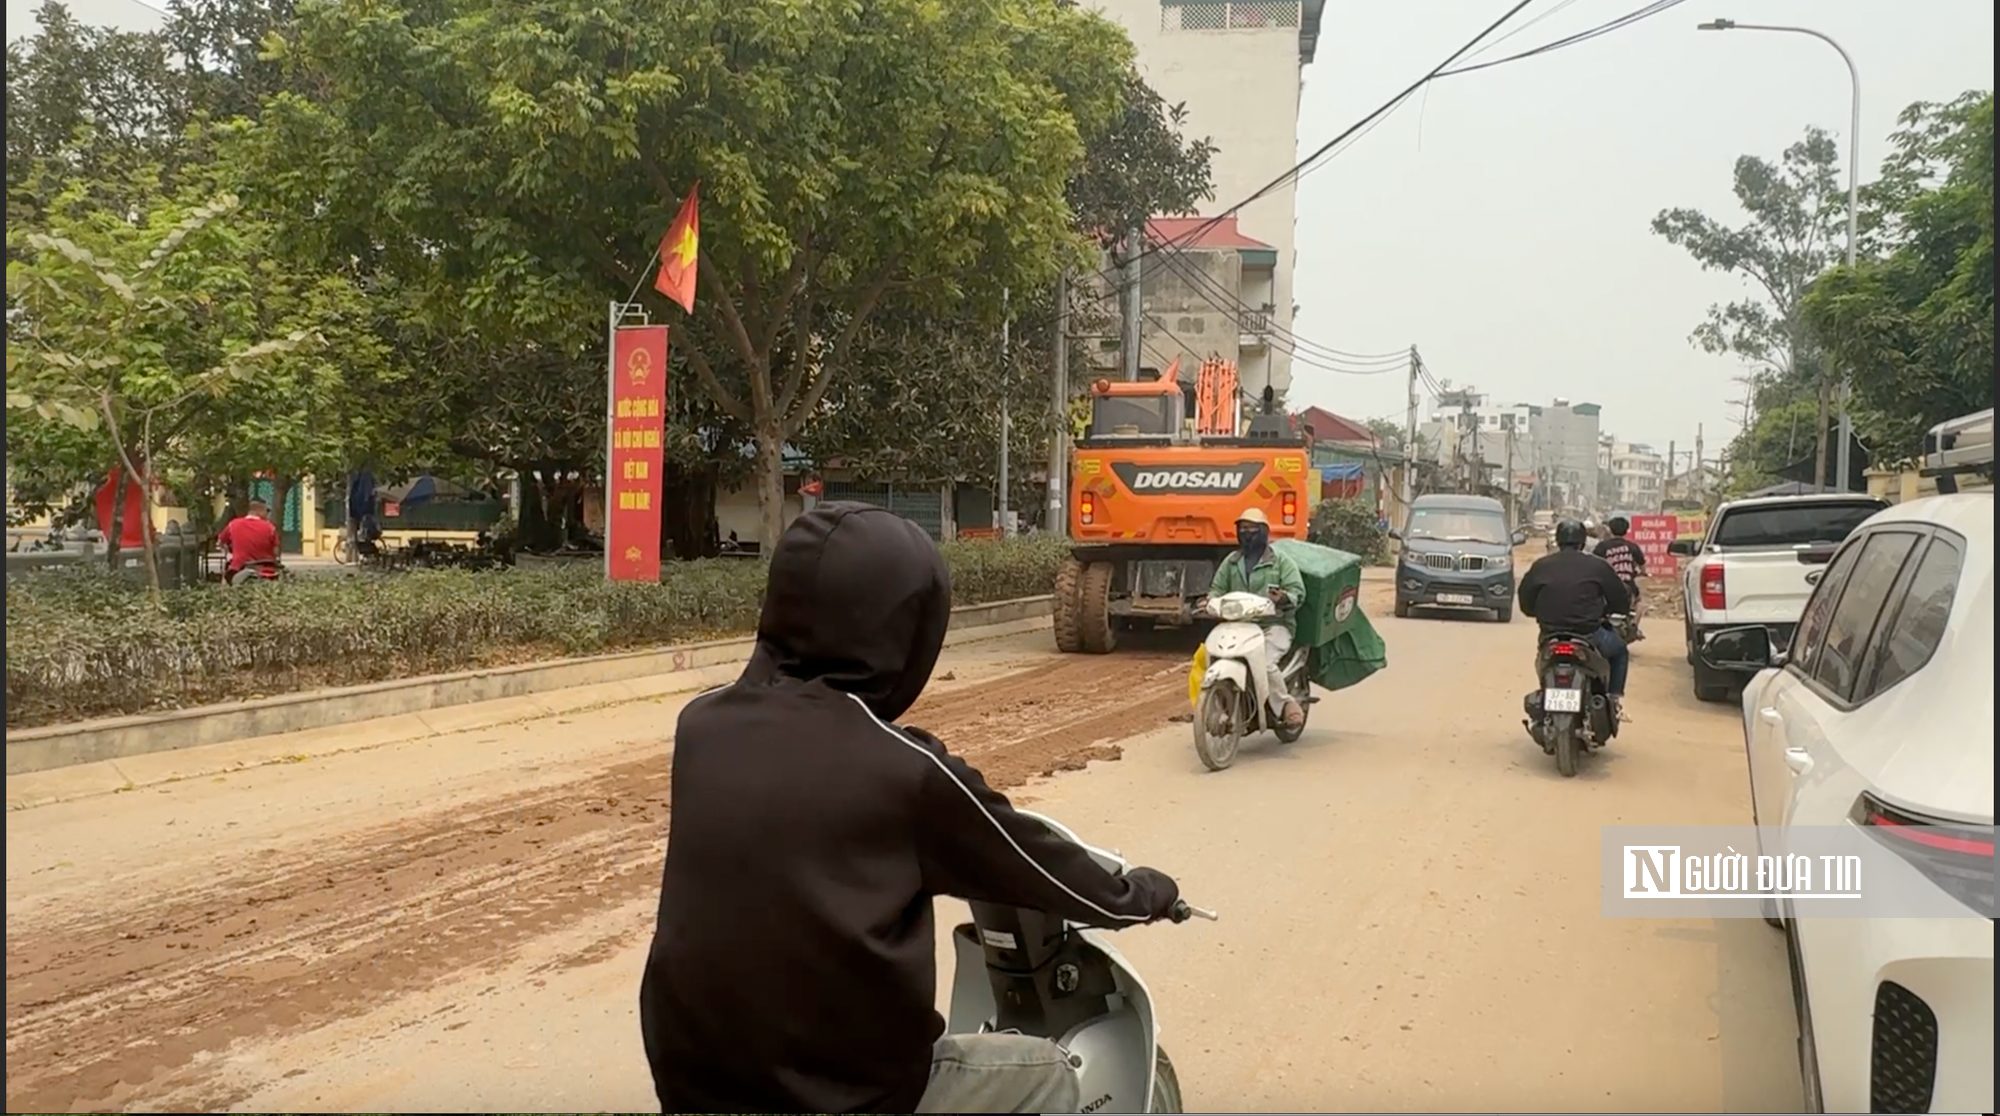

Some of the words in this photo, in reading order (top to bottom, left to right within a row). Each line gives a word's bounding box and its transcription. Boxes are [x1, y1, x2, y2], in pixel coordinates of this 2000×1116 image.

[1133, 471, 1243, 489] DOOSAN
[1634, 528, 1657, 540] RỬA
[1659, 530, 1674, 541] XE
